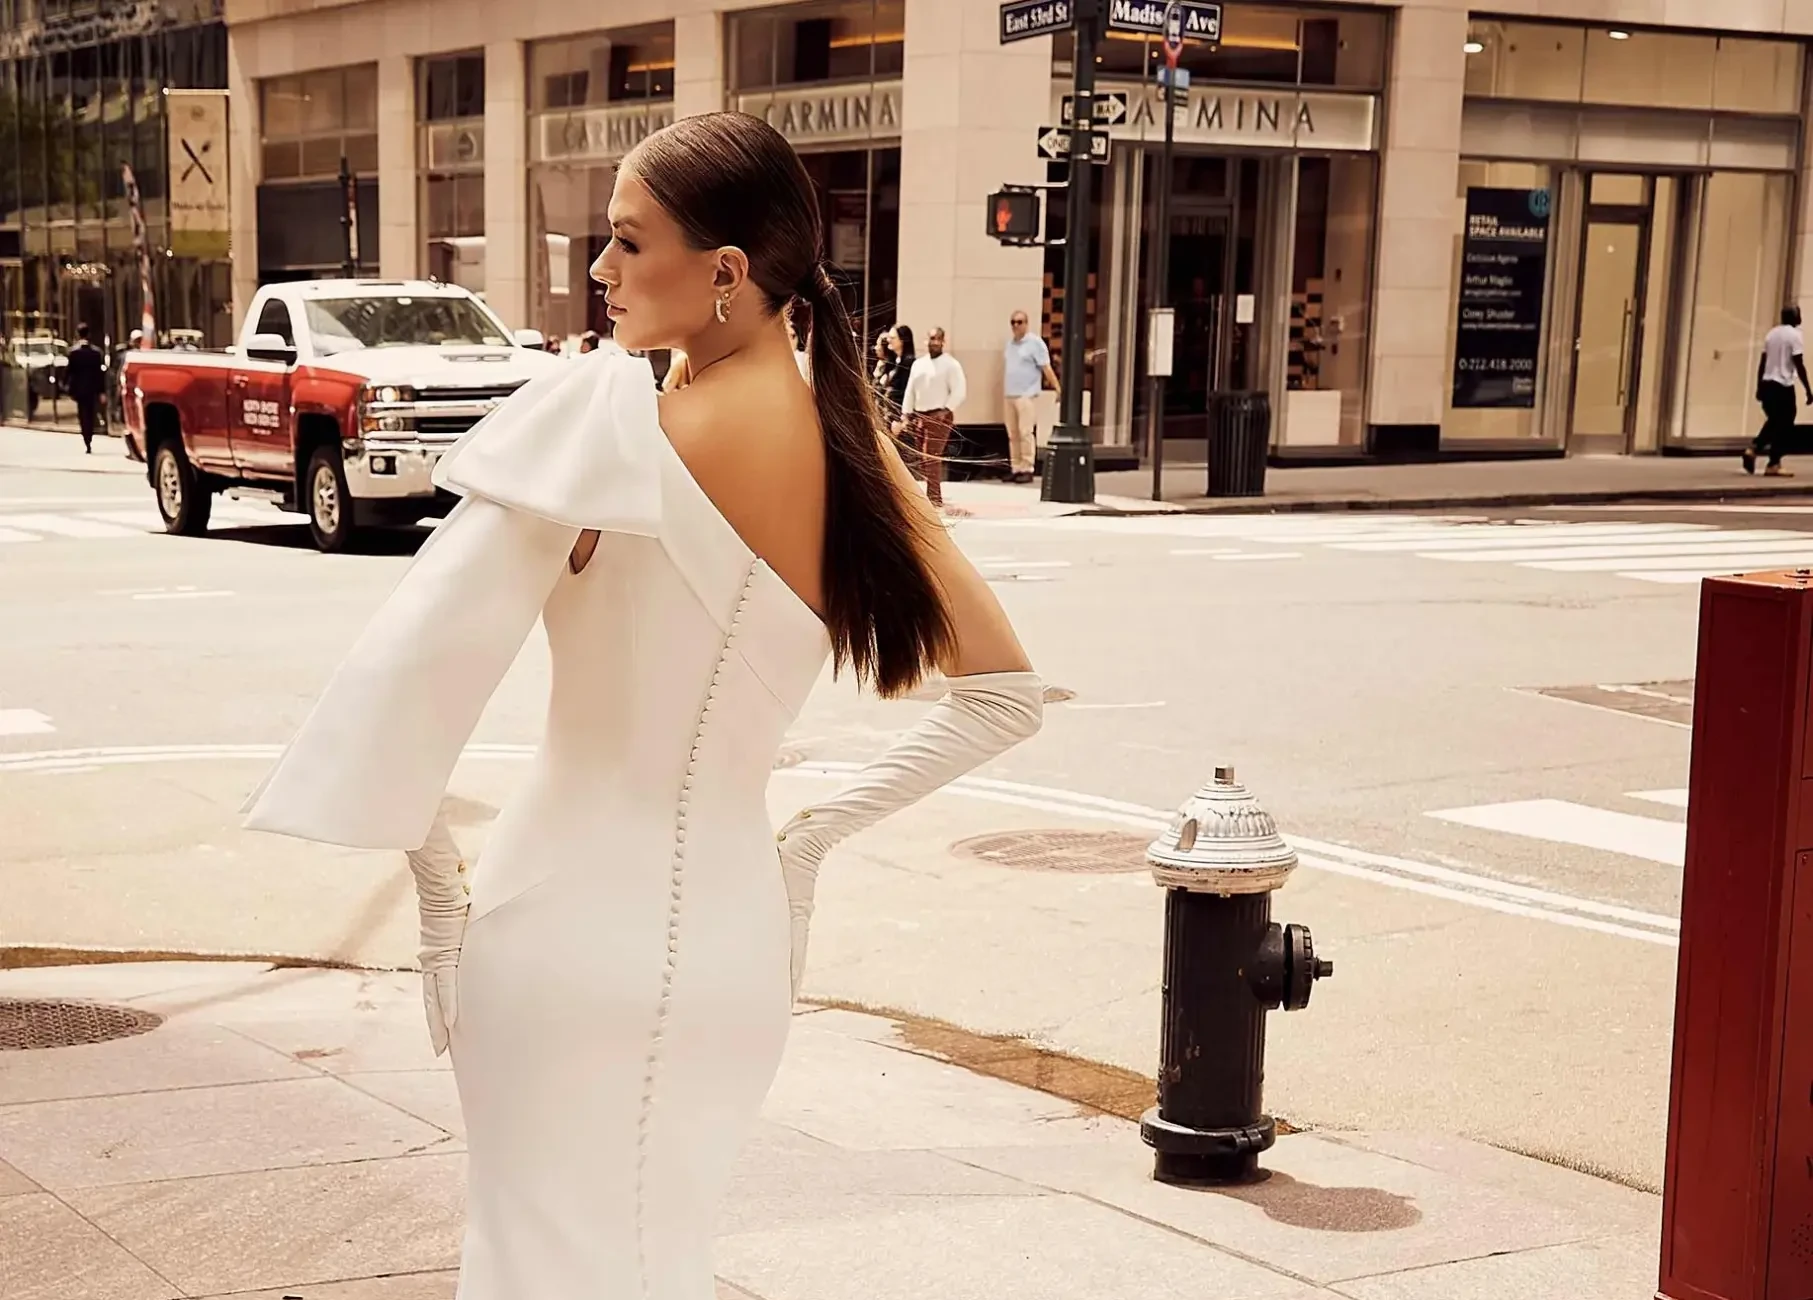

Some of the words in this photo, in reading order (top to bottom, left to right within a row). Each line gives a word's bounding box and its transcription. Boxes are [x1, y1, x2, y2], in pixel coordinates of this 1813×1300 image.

[1006, 13, 1028, 33] East
[1030, 5, 1053, 28] 53rd
[1055, 2, 1067, 22] St
[1112, 0, 1164, 25] Madis
[1186, 10, 1216, 32] Ave
[1470, 226, 1496, 238] SPACE
[1499, 227, 1544, 239] AVAILABLE
